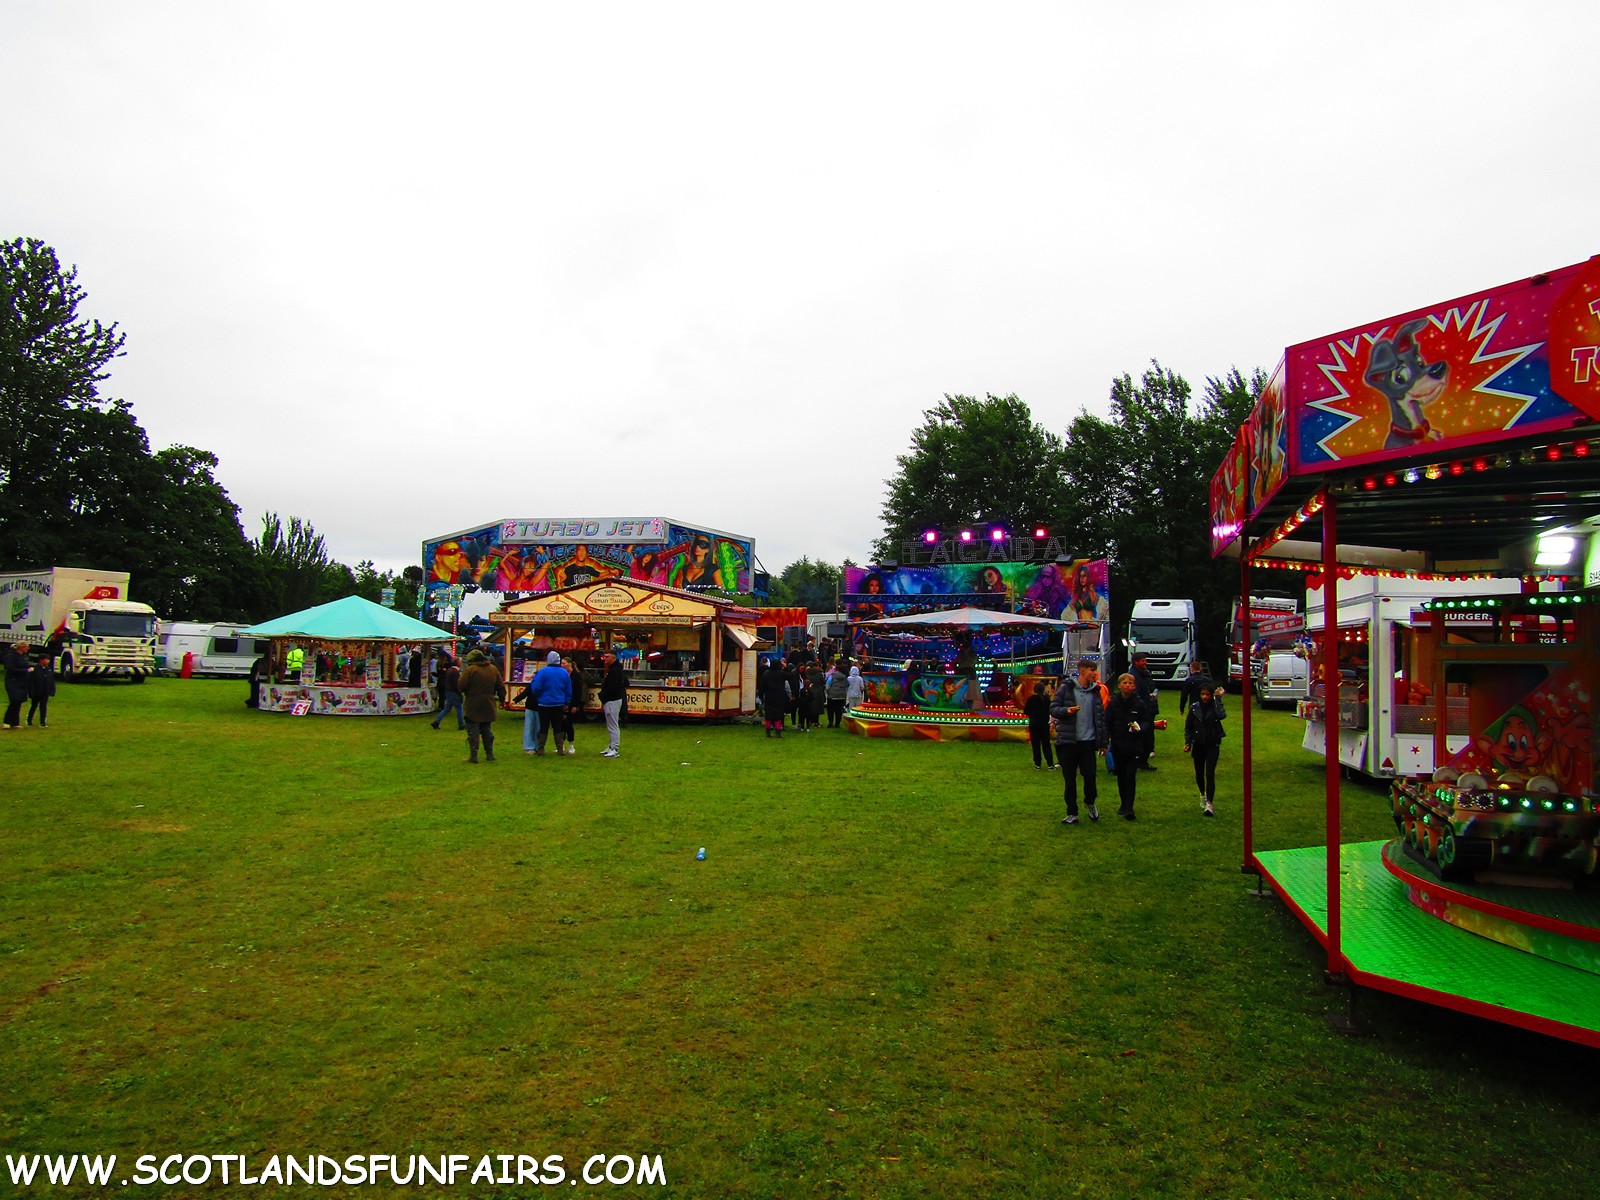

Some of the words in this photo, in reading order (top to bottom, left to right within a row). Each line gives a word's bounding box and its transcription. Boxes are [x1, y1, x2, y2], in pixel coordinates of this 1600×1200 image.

[518, 521, 600, 537] TURBO
[606, 520, 652, 536] JET
[536, 545, 575, 565] MUSIC
[588, 545, 632, 566] EXPLOSION
[902, 536, 1064, 564] TAGADA
[15, 580, 51, 596] ATTRACTIONS
[294, 702, 309, 715] £1
